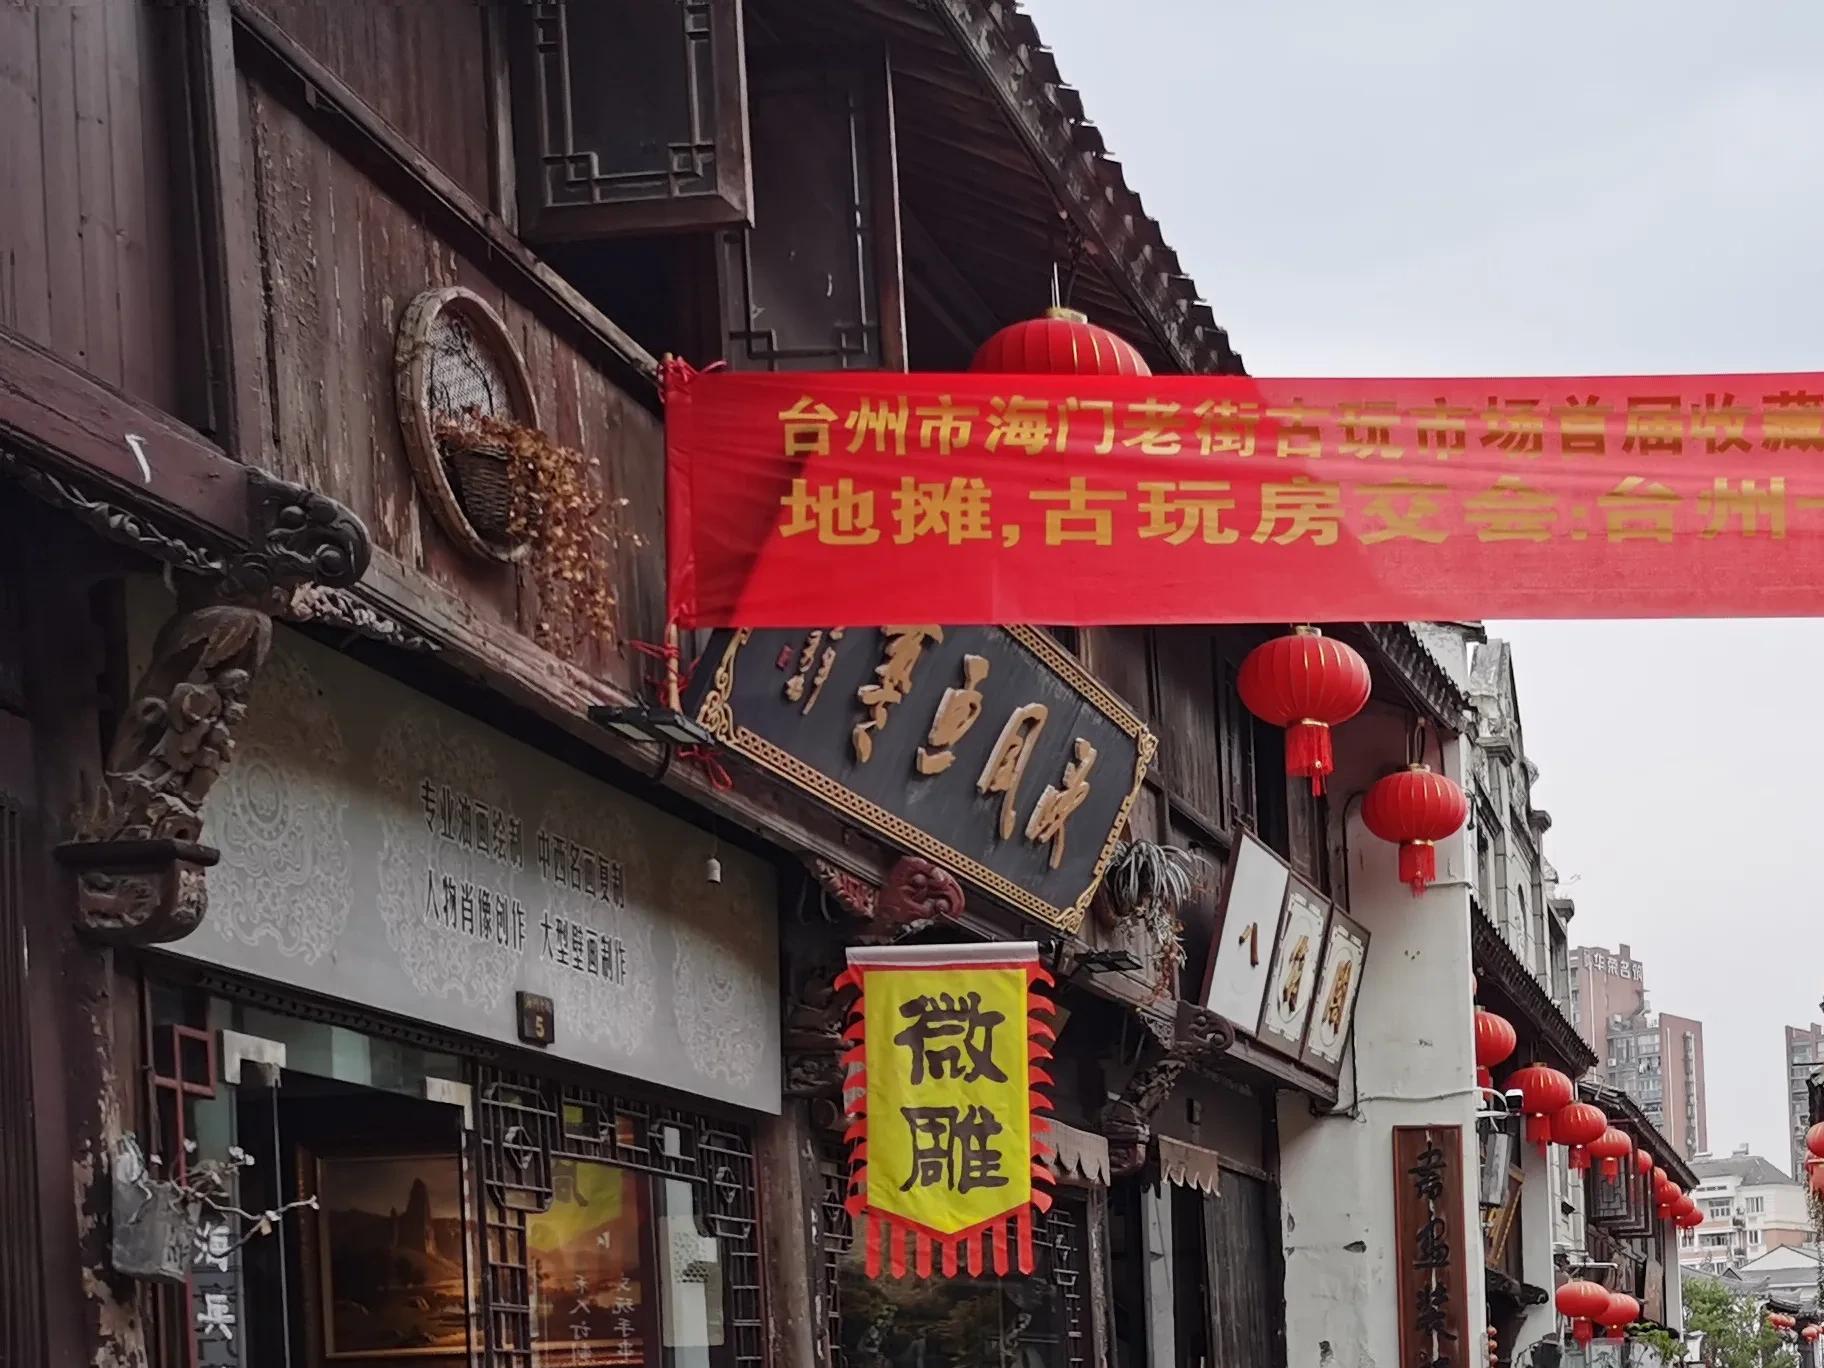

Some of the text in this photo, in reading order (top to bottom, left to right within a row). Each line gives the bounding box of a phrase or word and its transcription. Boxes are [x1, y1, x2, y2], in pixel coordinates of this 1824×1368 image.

[421, 779, 624, 908] 专业油画绘制 中西名画复制
[423, 869, 627, 986] 人物肖像创作 大型壁画制作
[893, 991, 1009, 1194] 微雕
